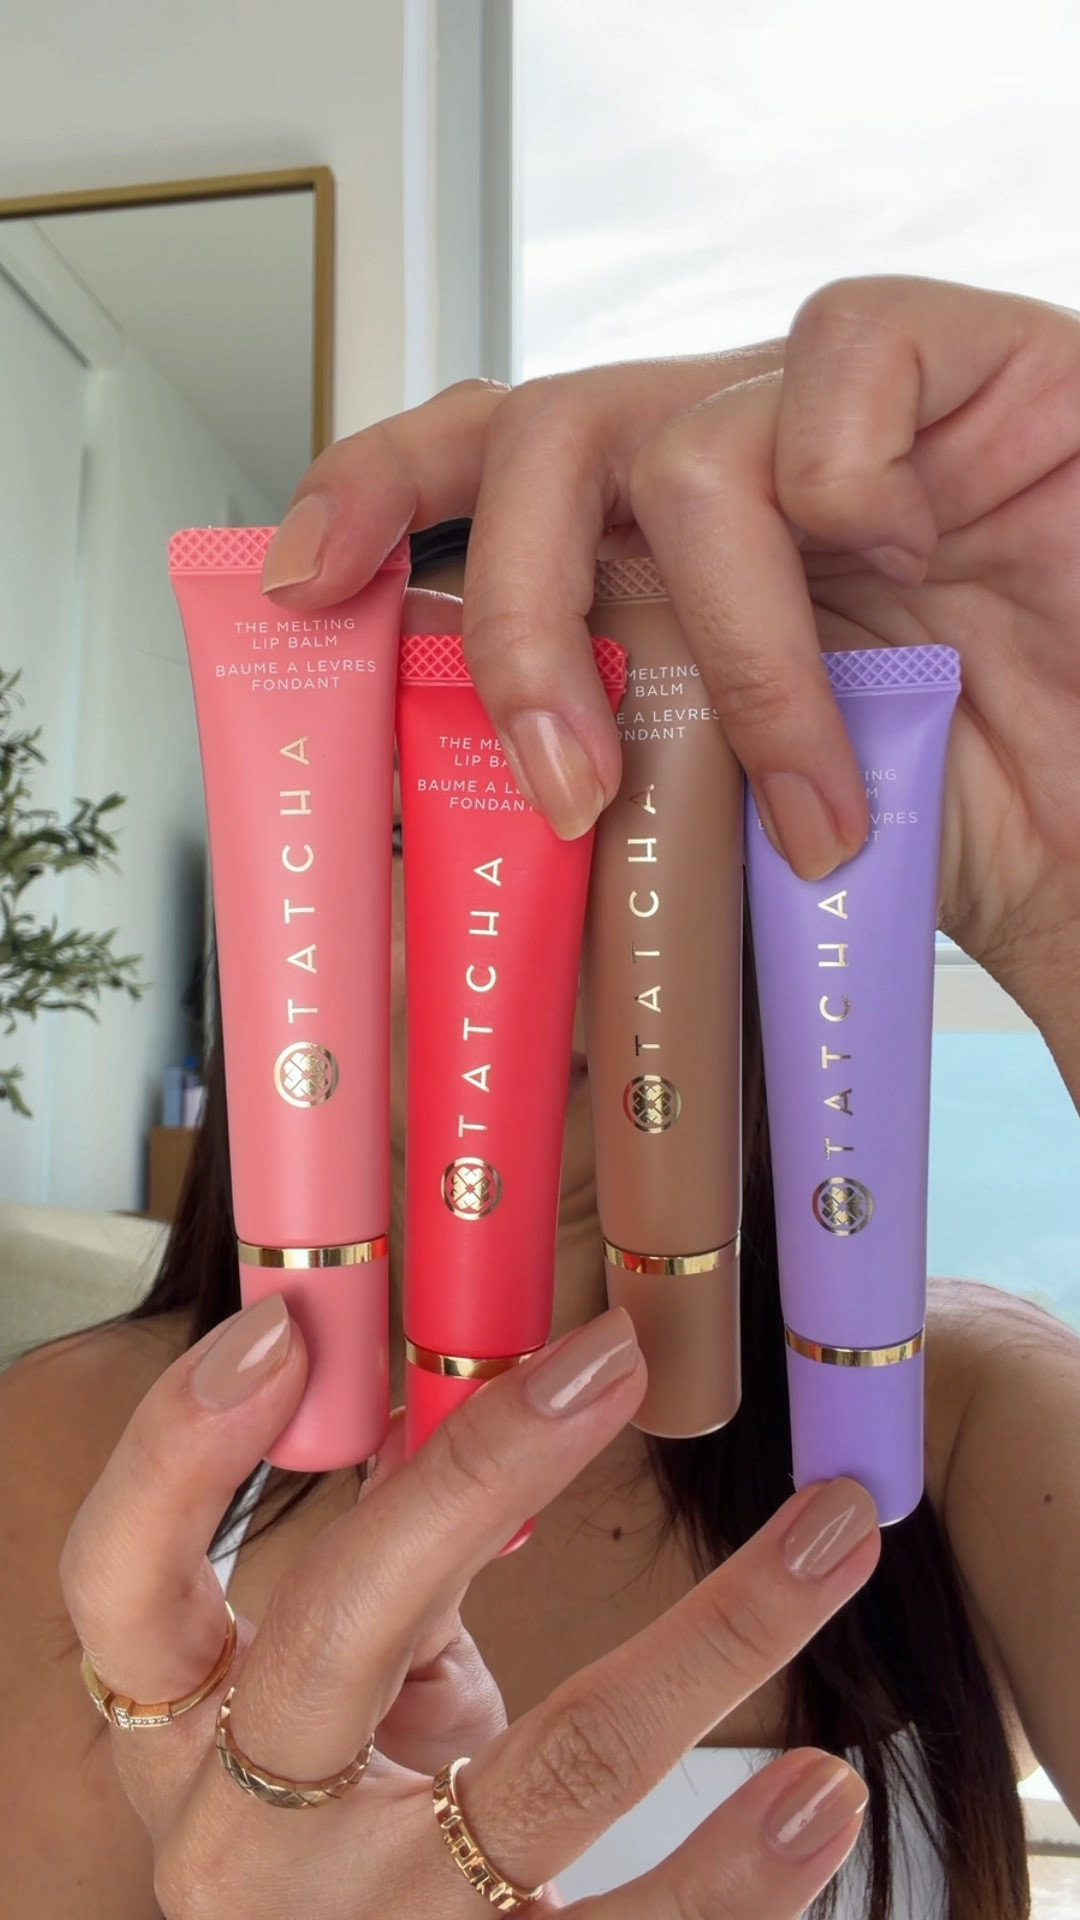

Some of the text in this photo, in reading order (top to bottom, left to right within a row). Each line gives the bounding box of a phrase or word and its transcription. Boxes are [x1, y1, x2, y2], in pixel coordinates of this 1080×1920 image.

[234, 618, 355, 633] THE MELTING
[252, 635, 338, 650] LIP BALM
[216, 660, 376, 677] BAUME A LEVRES
[252, 676, 341, 691] FONDANT
[635, 683, 683, 697] BALM
[633, 712, 645, 723] A
[618, 726, 686, 741] NDANT
[439, 736, 472, 750] THE
[454, 754, 481, 767] LIP
[417, 779, 477, 792] BAUME
[485, 781, 496, 793] A
[449, 797, 533, 812] FONDAN
[870, 811, 918, 824] VRES
[279, 736, 318, 1023] TATCHA
[627, 784, 662, 1056] TATCHA
[458, 857, 503, 1138] TATCHA
[817, 890, 854, 1160] TATCHA
